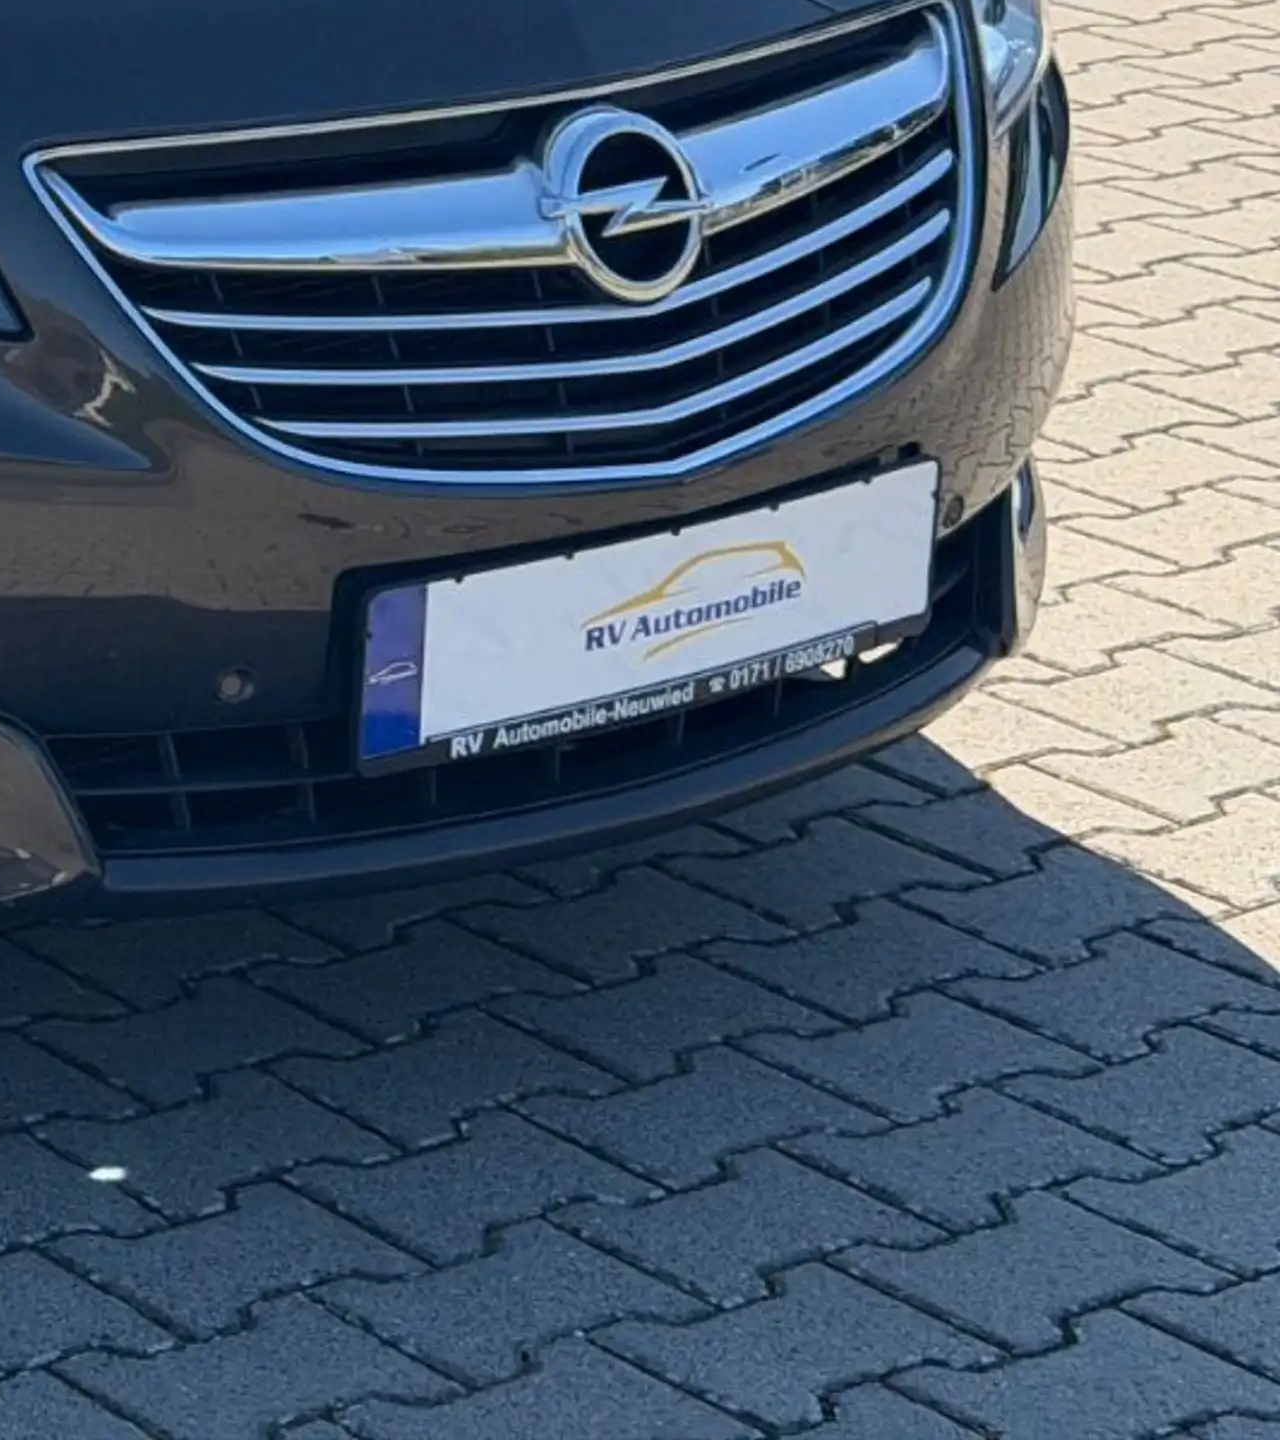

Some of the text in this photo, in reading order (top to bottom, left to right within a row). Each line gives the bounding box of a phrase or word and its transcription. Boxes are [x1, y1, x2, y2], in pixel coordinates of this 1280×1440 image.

[585, 578, 802, 652] RV Automobile
[451, 731, 484, 759] RV
[493, 681, 695, 750] Automobile-Neuwied
[729, 660, 770, 690] 0171
